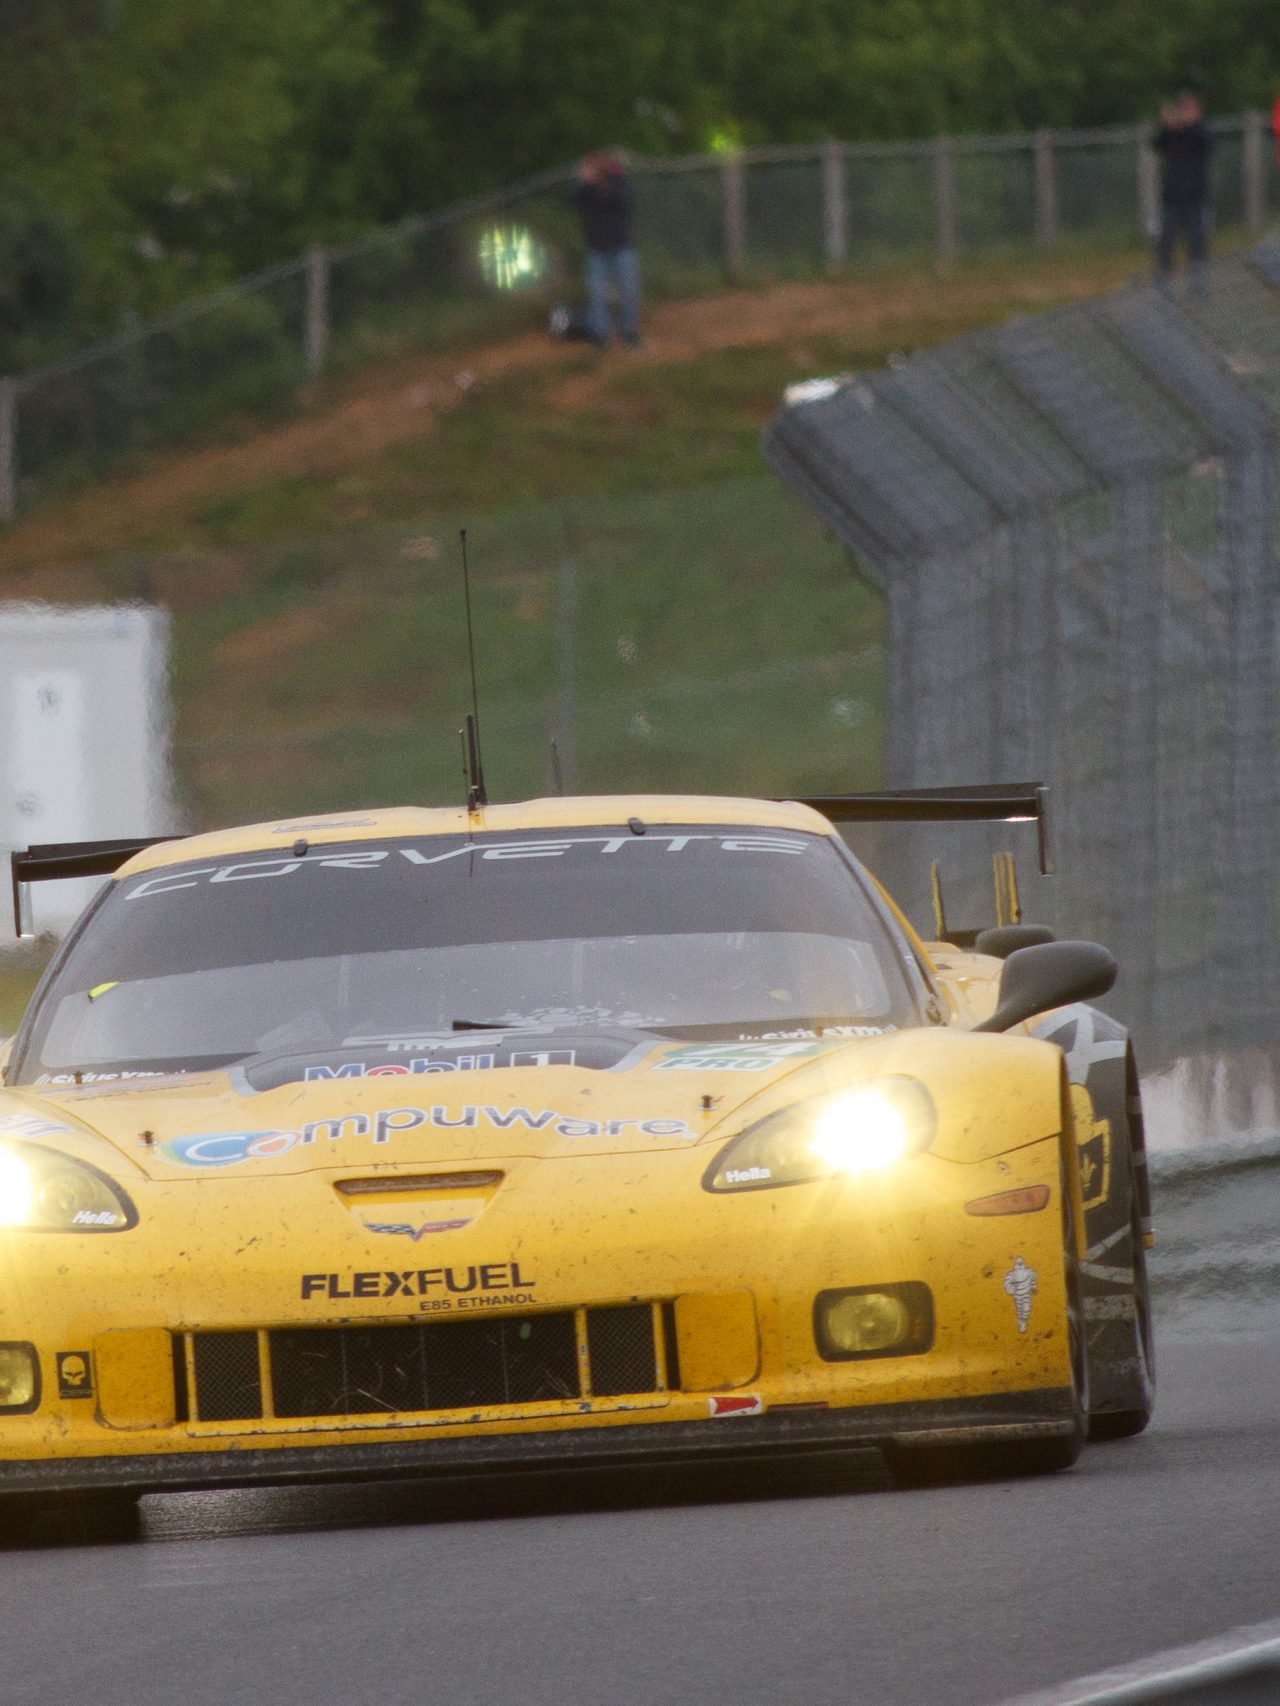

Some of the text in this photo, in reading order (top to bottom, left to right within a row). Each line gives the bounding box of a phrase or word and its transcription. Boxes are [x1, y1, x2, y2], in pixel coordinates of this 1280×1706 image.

[125, 834, 811, 901] CORVETTE
[304, 1053, 495, 1082] Mobil
[659, 1057, 774, 1070] PRO
[183, 1104, 688, 1160] Compuware
[725, 1167, 772, 1183] Hella
[71, 1210, 118, 1225] Hella
[300, 1262, 536, 1300] FLEXFUEL
[420, 1292, 537, 1312] E85 ETHANOL
